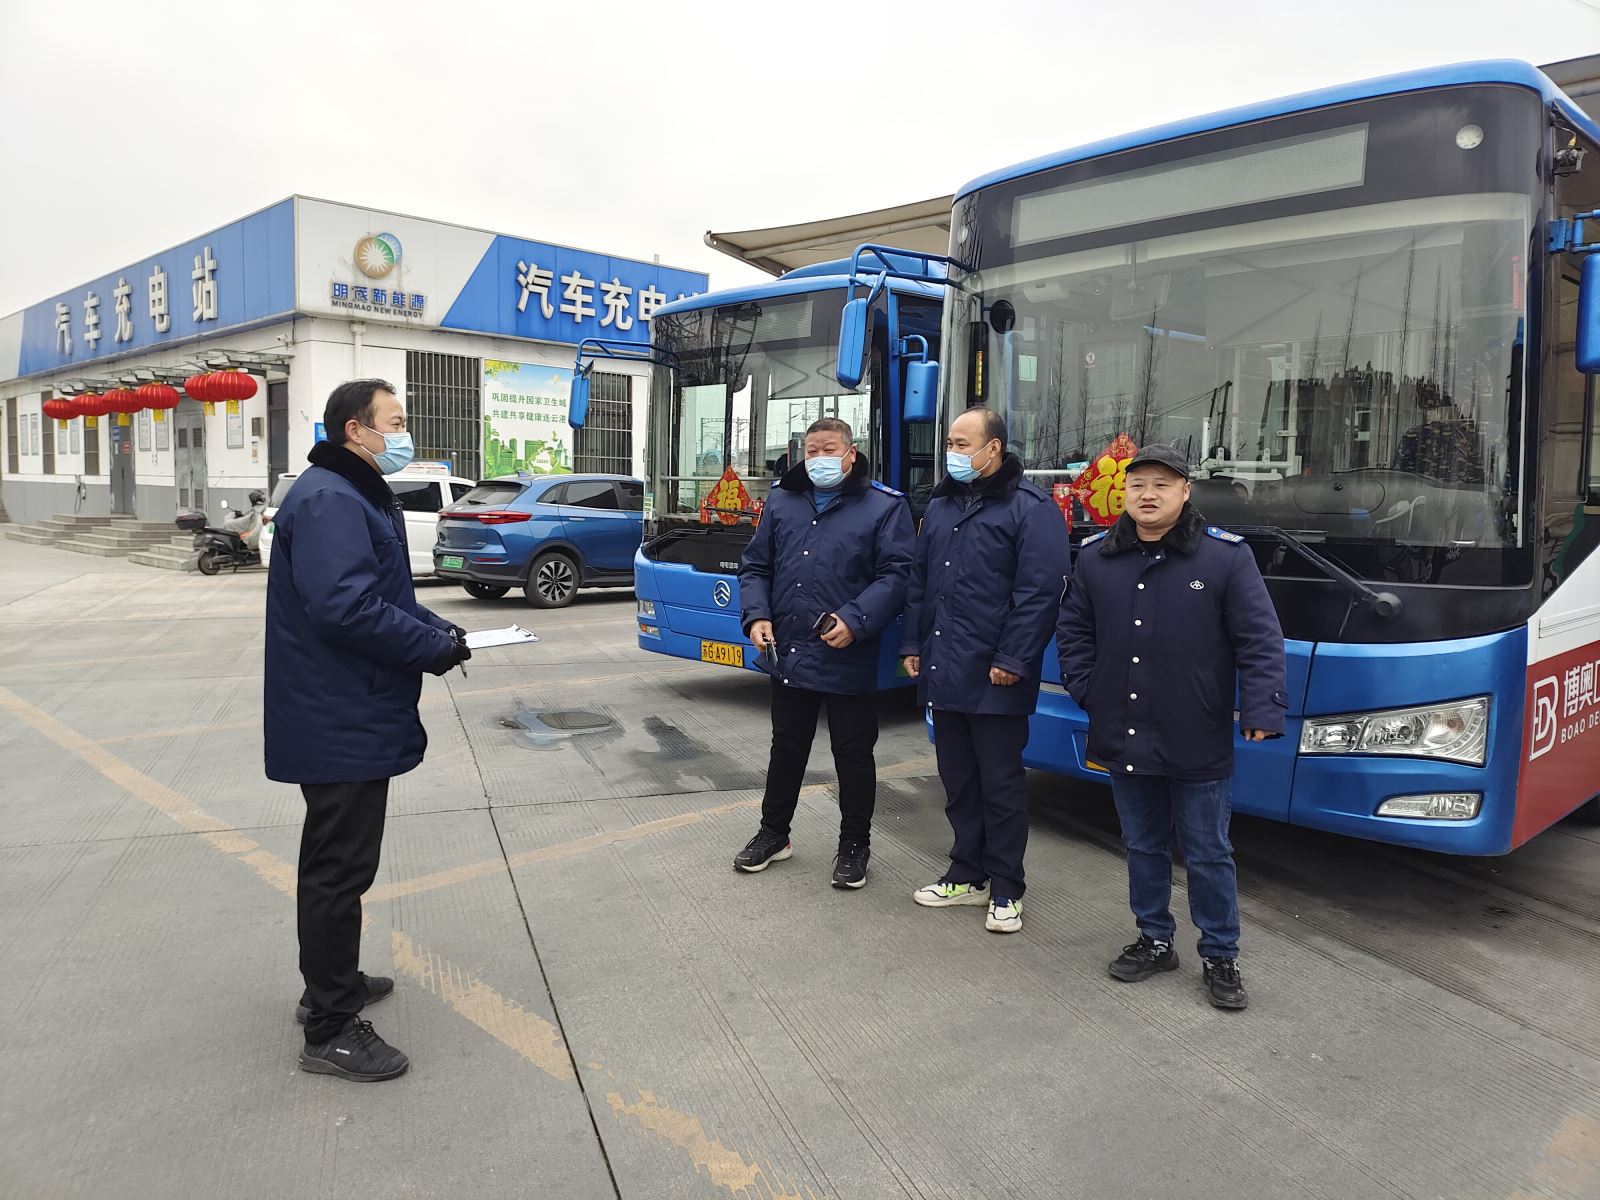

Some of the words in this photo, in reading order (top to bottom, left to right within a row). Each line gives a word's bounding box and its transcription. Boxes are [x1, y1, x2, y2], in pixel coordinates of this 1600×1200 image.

[55, 246, 218, 355] 汽车充电站
[332, 300, 372, 311] MINGMAO
[373, 307, 393, 315] NEW
[393, 308, 424, 318] ENERGY
[516, 260, 700, 333] 汽车充电
[717, 479, 741, 517] 福
[1561, 718, 1586, 744] BOAO
